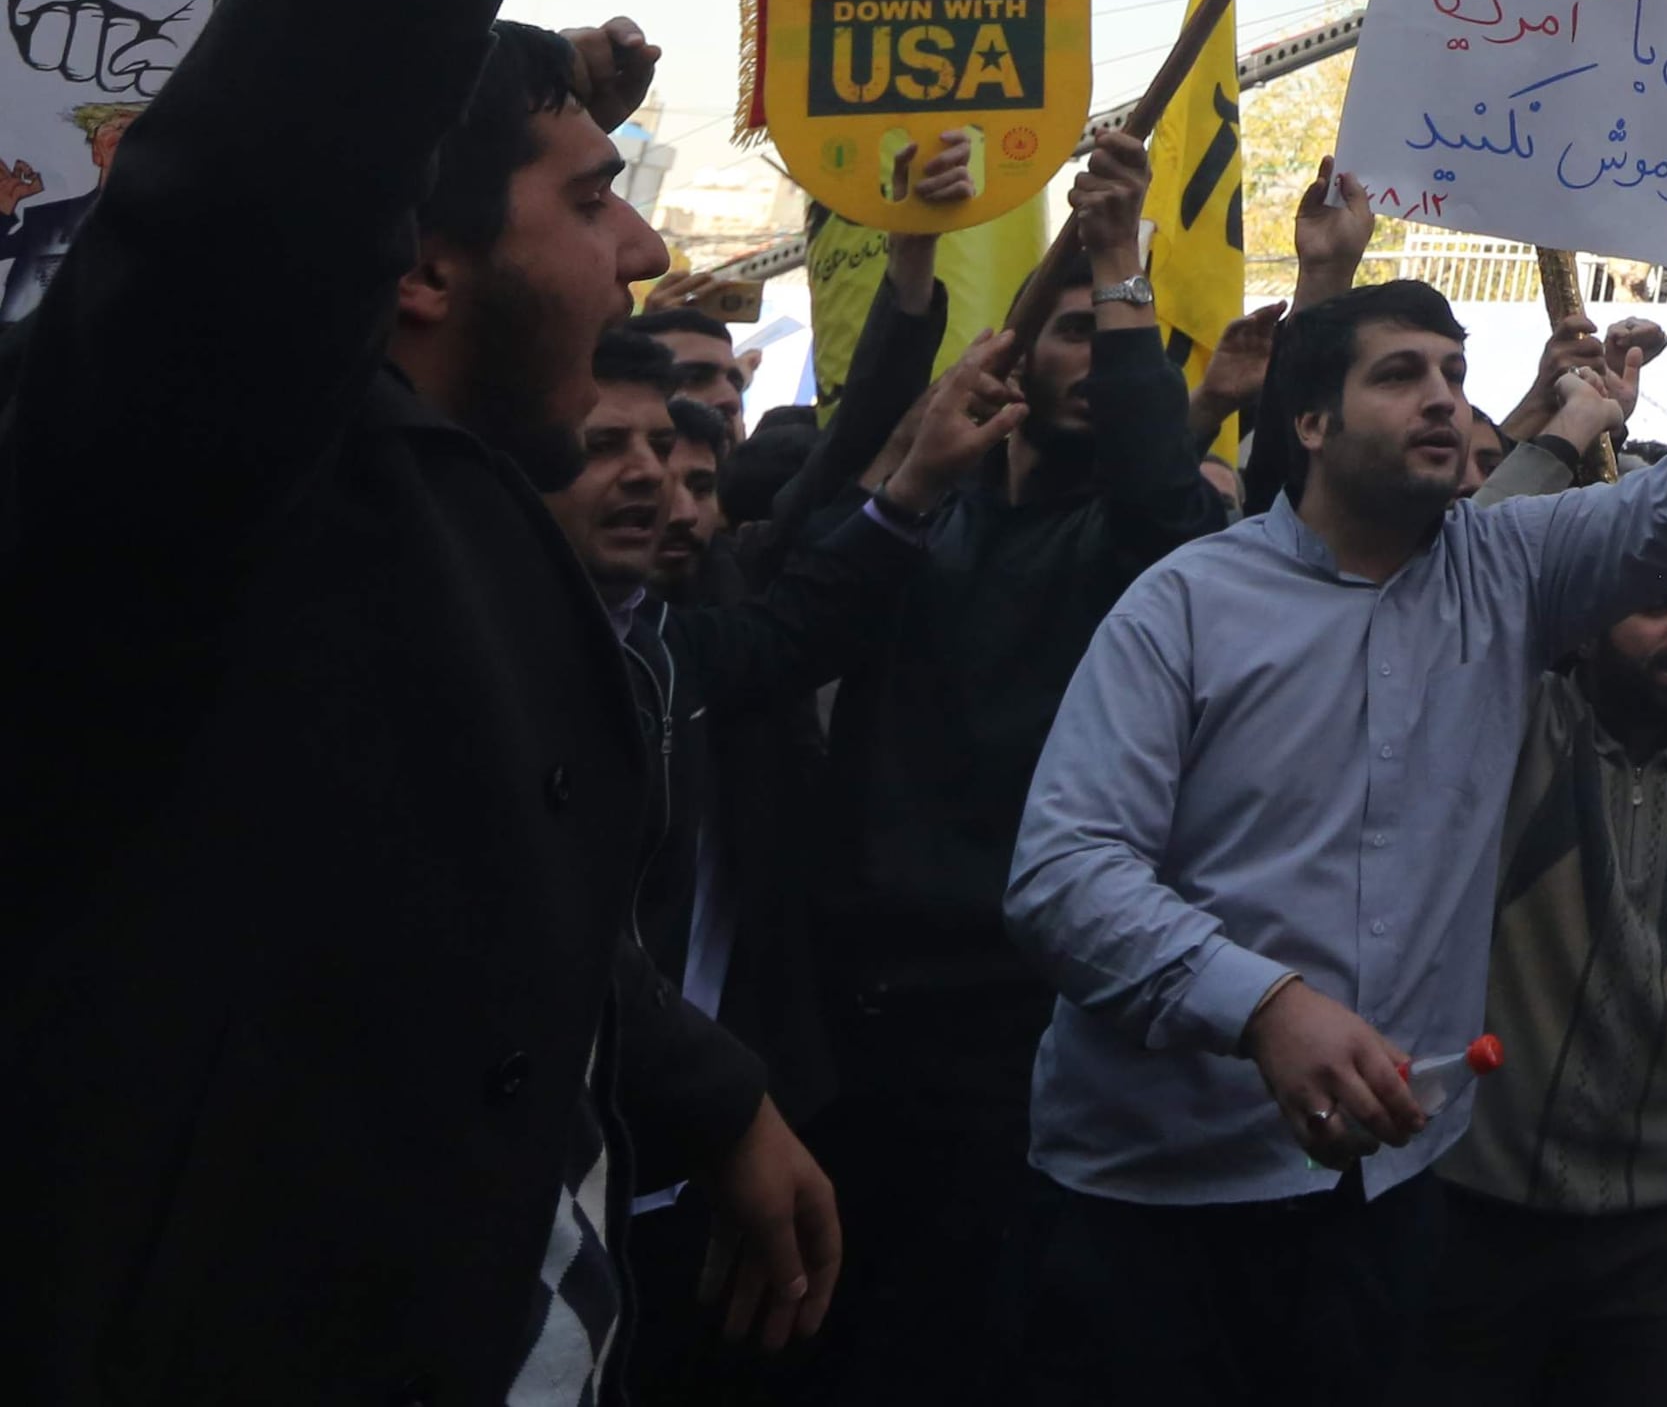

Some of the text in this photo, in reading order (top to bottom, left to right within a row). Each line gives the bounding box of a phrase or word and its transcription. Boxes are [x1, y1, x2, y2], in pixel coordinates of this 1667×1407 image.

[834, 1, 933, 23] DOWN
[831, 24, 1024, 104] USA
[1404, 63, 1600, 182] نکنید
